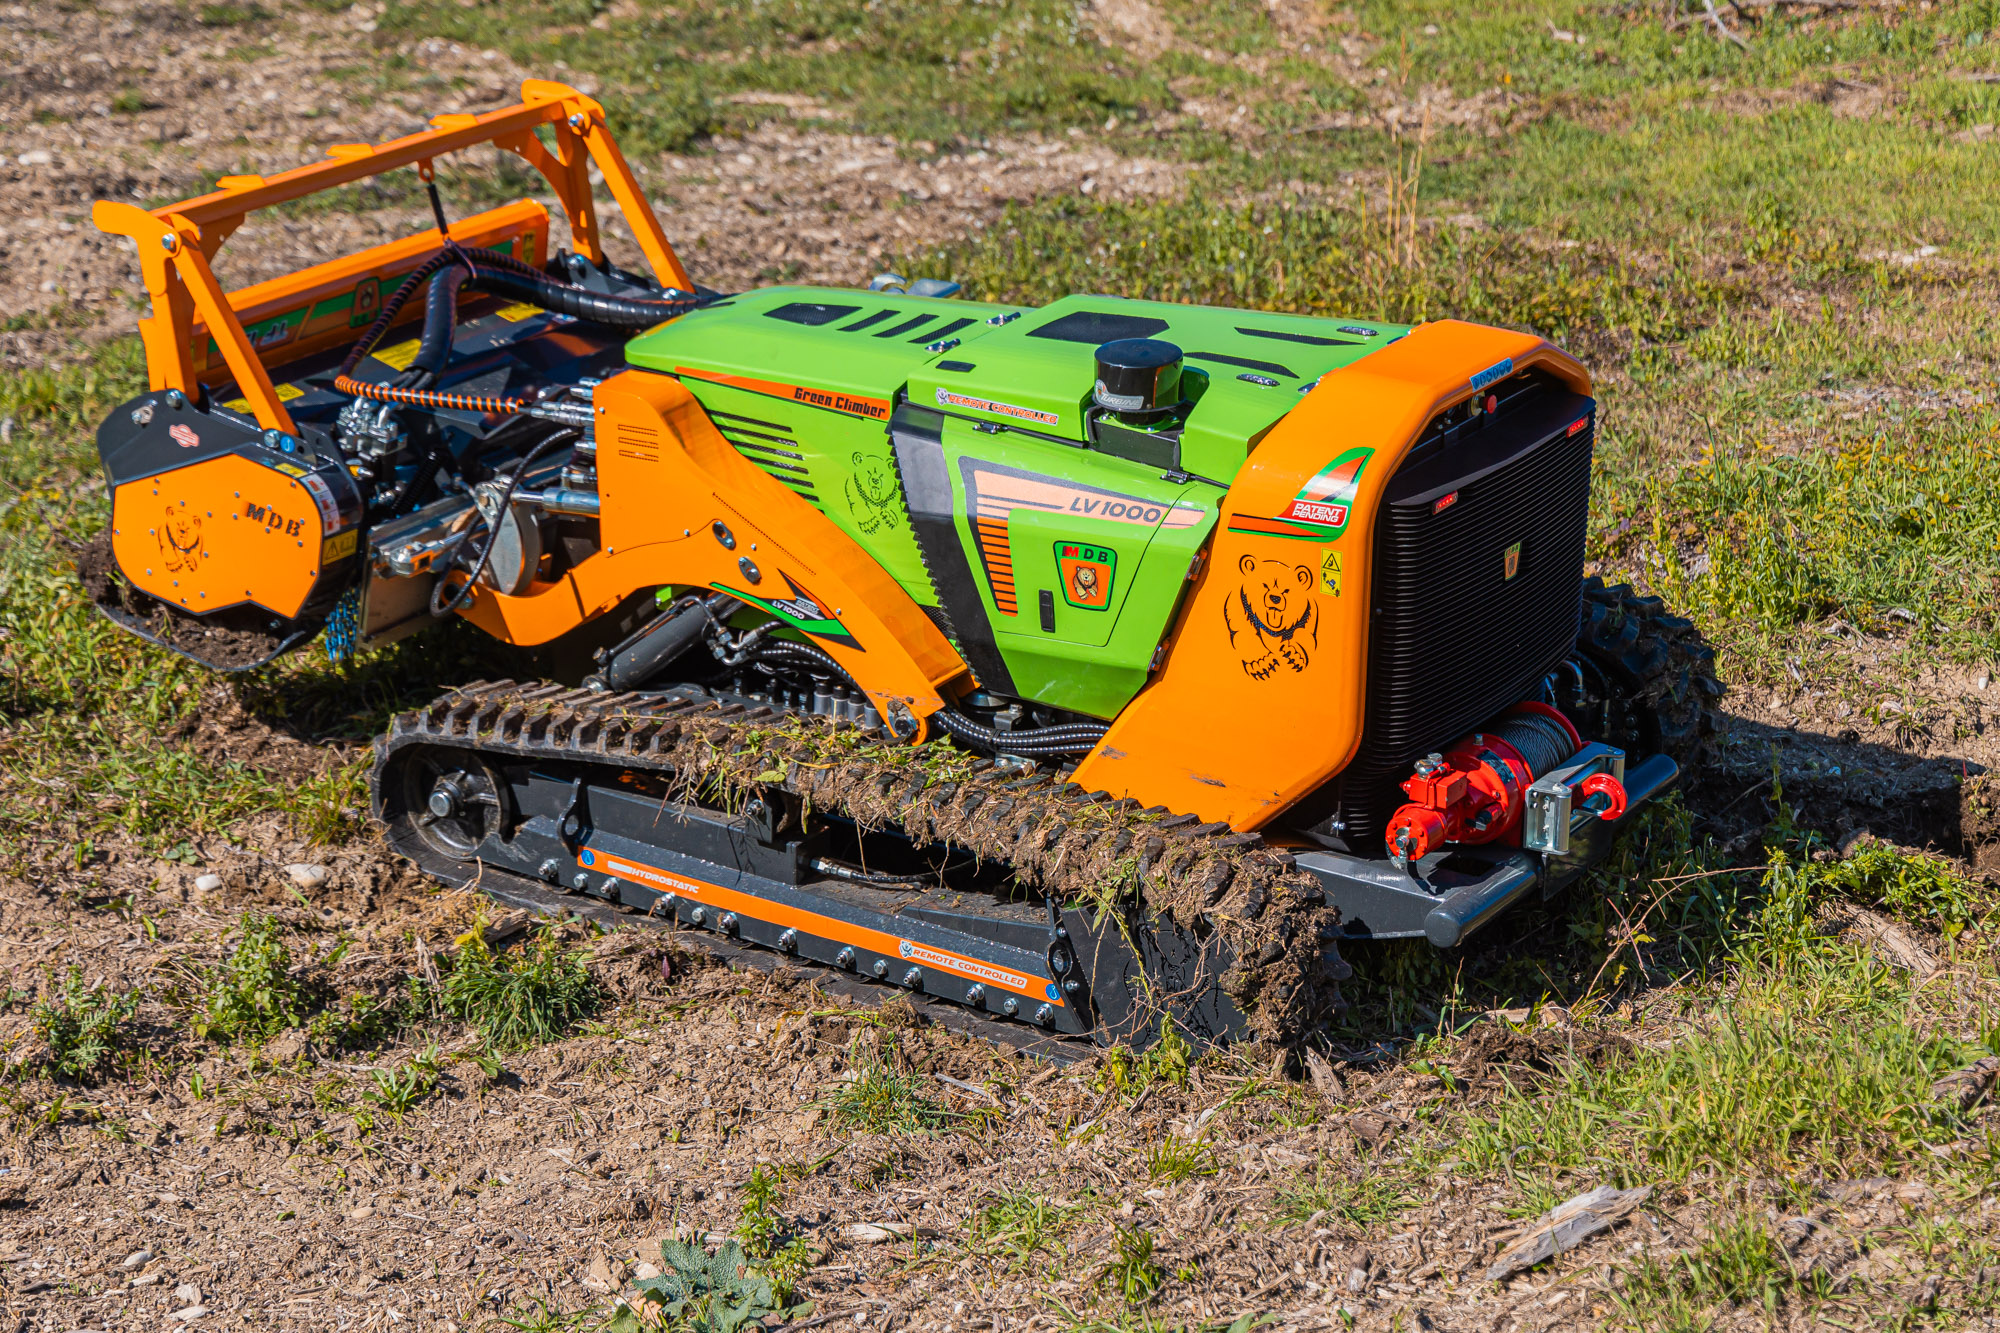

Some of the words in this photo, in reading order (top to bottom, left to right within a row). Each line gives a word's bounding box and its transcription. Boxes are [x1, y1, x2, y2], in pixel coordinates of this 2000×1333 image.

[794, 387, 832, 406] Green
[835, 395, 886, 418] Climber
[948, 394, 991, 411] REMOTE
[991, 402, 1058, 425] CONTROLLED
[1101, 393, 1142, 406] TURBINE
[1292, 510, 1340, 523] PENDING
[1294, 503, 1343, 516] PATENT
[631, 868, 700, 894] HYDROSTATIC
[913, 949, 955, 966] REMOTE
[958, 961, 1025, 986] CONTROLLED
